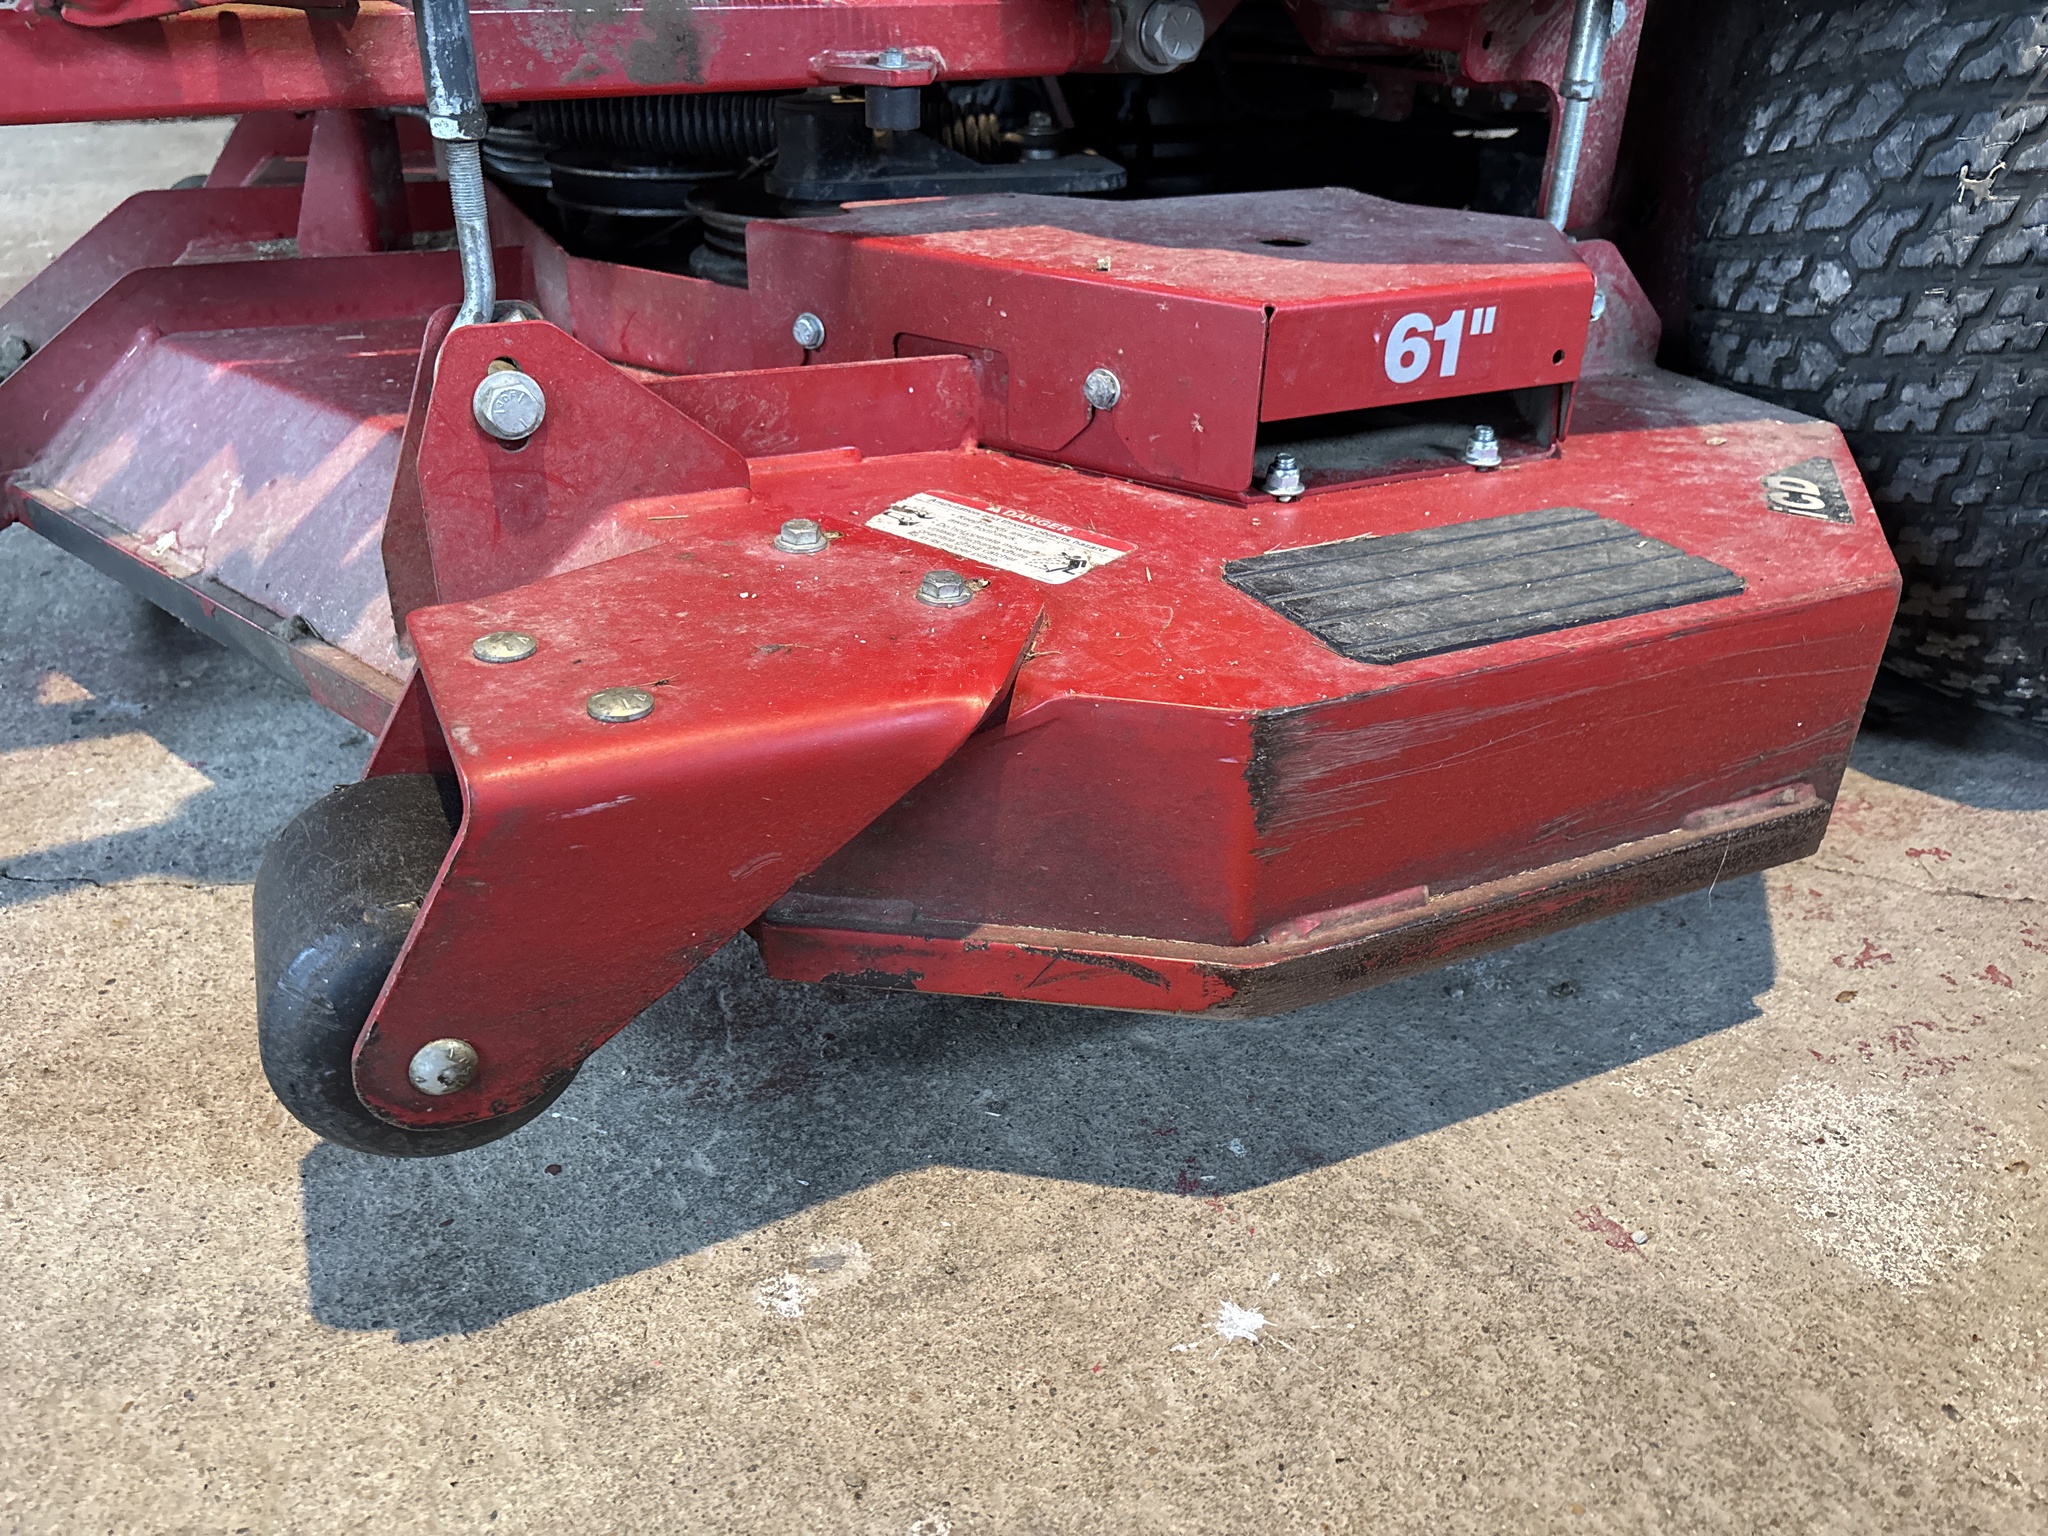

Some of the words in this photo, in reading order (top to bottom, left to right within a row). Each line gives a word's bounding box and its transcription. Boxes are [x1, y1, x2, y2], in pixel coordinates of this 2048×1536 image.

[1384, 306, 1497, 384] 61"
[928, 498, 981, 516] Amputation
[1001, 519, 1035, 532] thrown
[1035, 530, 1072, 543] objects
[1072, 540, 1108, 553] hazard
[1001, 509, 1074, 533] DANGER
[973, 525, 994, 534] from
[1008, 531, 1029, 539] and
[1028, 536, 1048, 545] feet
[981, 549, 1019, 562] catcher
[1001, 542, 1032, 555] mower
